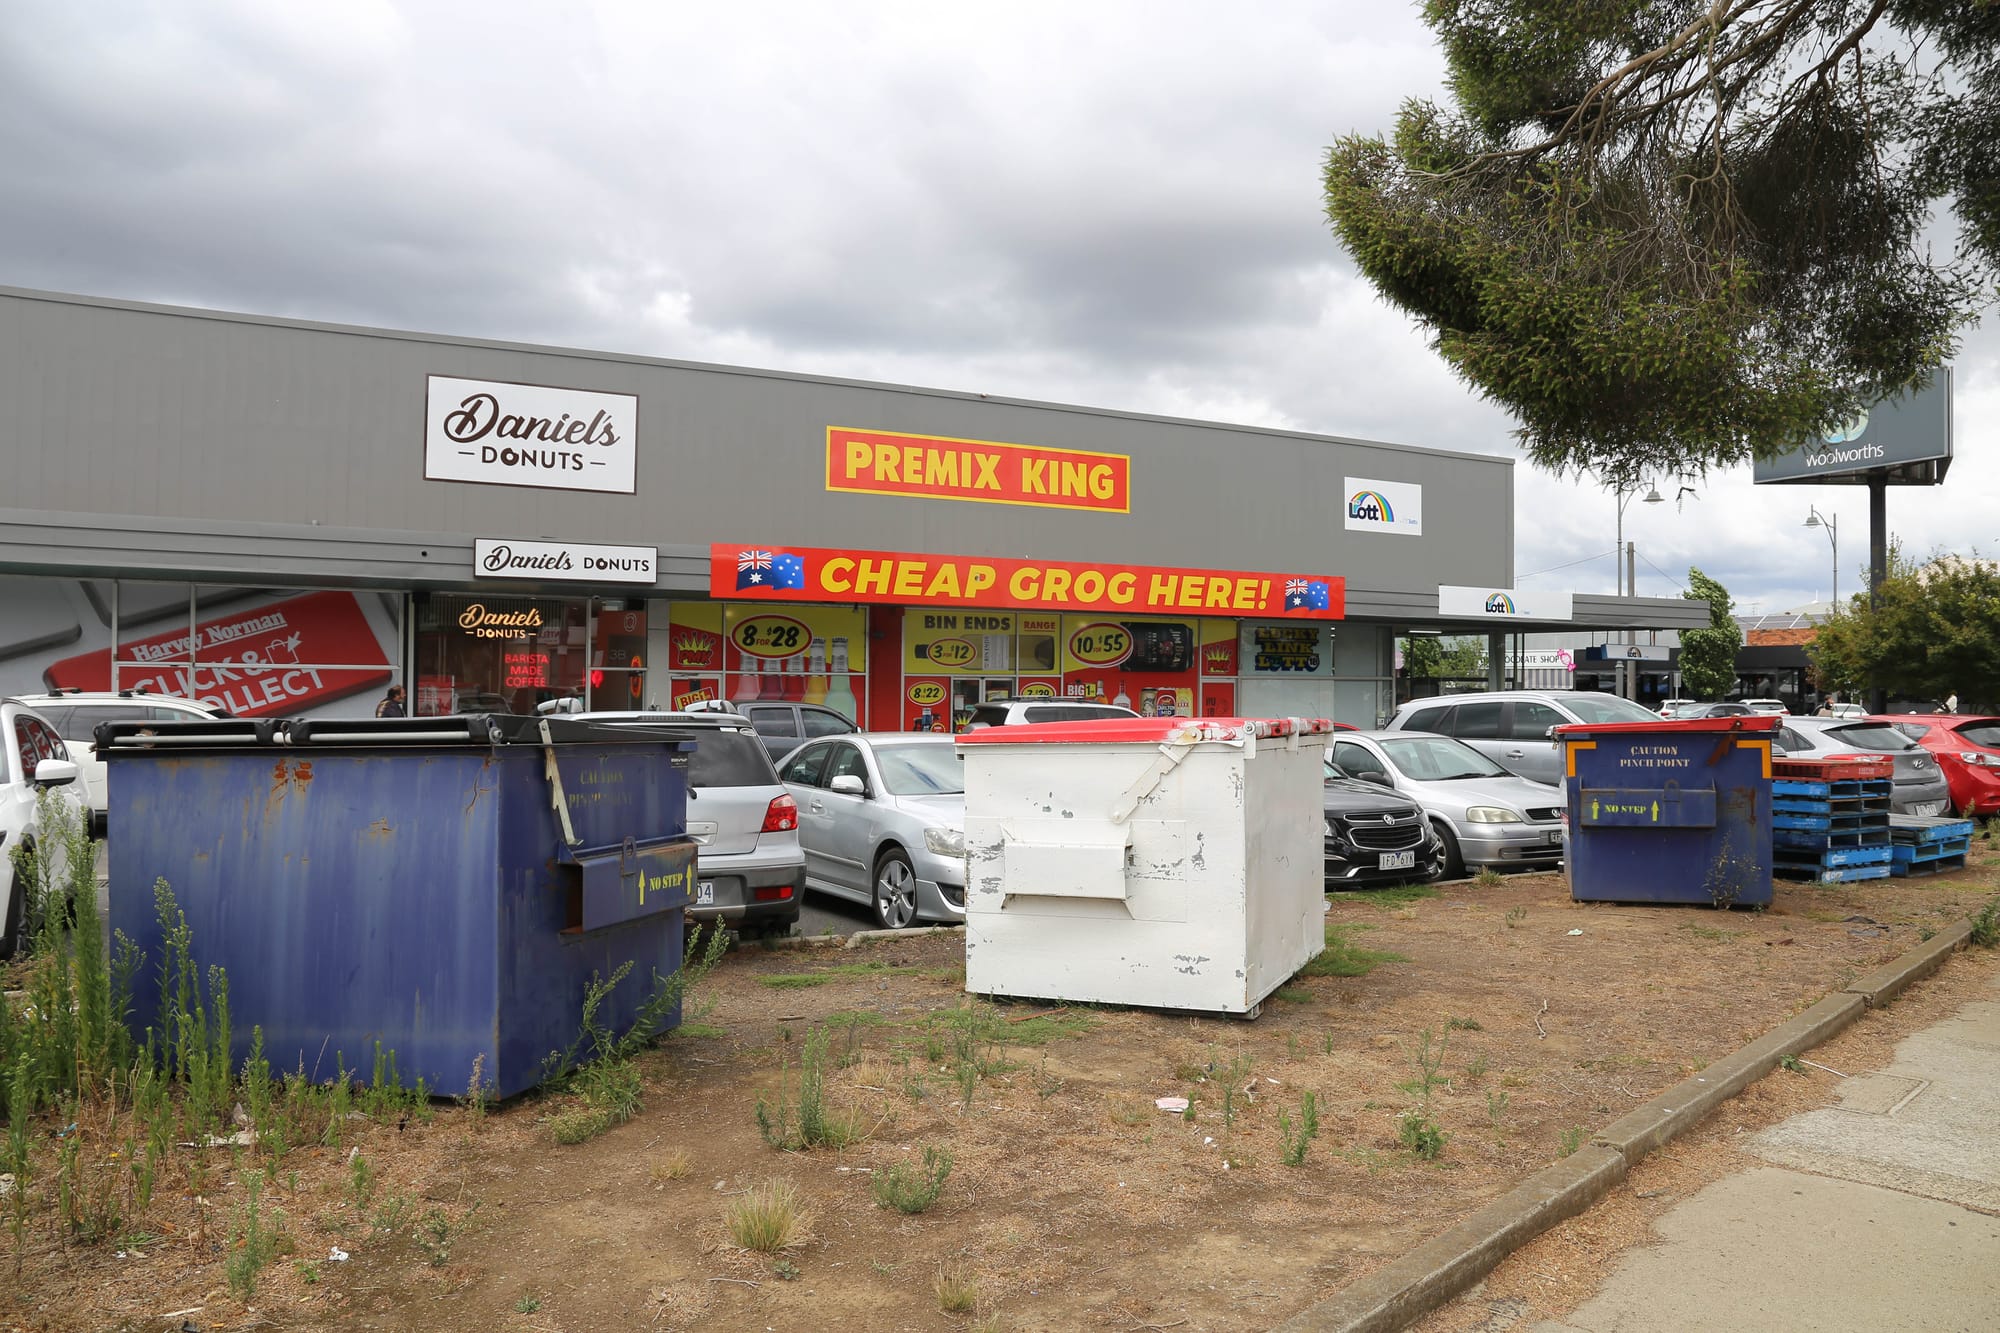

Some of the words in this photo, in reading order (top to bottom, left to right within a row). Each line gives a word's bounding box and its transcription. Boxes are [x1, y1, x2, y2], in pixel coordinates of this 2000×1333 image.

[443, 393, 620, 446] Daniel's
[481, 446, 584, 471] DONUTS
[1806, 444, 1884, 467] woolworths
[846, 441, 1002, 490] PREMIX
[1022, 457, 1114, 500] KING
[483, 545, 574, 572] Daniel's
[583, 557, 650, 572] DONUTS
[820, 557, 996, 599] CHEAP
[1009, 566, 1137, 604] GROG
[1147, 573, 1272, 610] HERE!
[458, 604, 544, 629] Daniel's
[924, 615, 957, 629] BIN
[964, 615, 1011, 631] ENDS
[1023, 621, 1056, 630] RANGE
[130, 633, 203, 662] Harvey
[205, 612, 288, 643] Norman
[476, 628, 526, 639] DONUTS
[742, 625, 758, 647] 8
[767, 624, 800, 647] $28
[1077, 636, 1093, 654] 10
[1098, 633, 1124, 652] $55
[1263, 642, 1312, 653] LINK
[504, 653, 550, 664] BARISTA
[933, 645, 943, 658] 3
[1541, 655, 1559, 663] SHOP
[510, 666, 543, 675] MADE
[505, 677, 546, 687] COFFEE
[1067, 684, 1085, 696] BIG
[1630, 746, 1678, 756] CAUTION
[1619, 759, 1653, 768] PINCH
[1656, 759, 1690, 768] POINT
[1604, 804, 1619, 813] NO
[1621, 805, 1647, 814] STEP
[649, 876, 661, 891] NO
[662, 873, 683, 889] STEP
